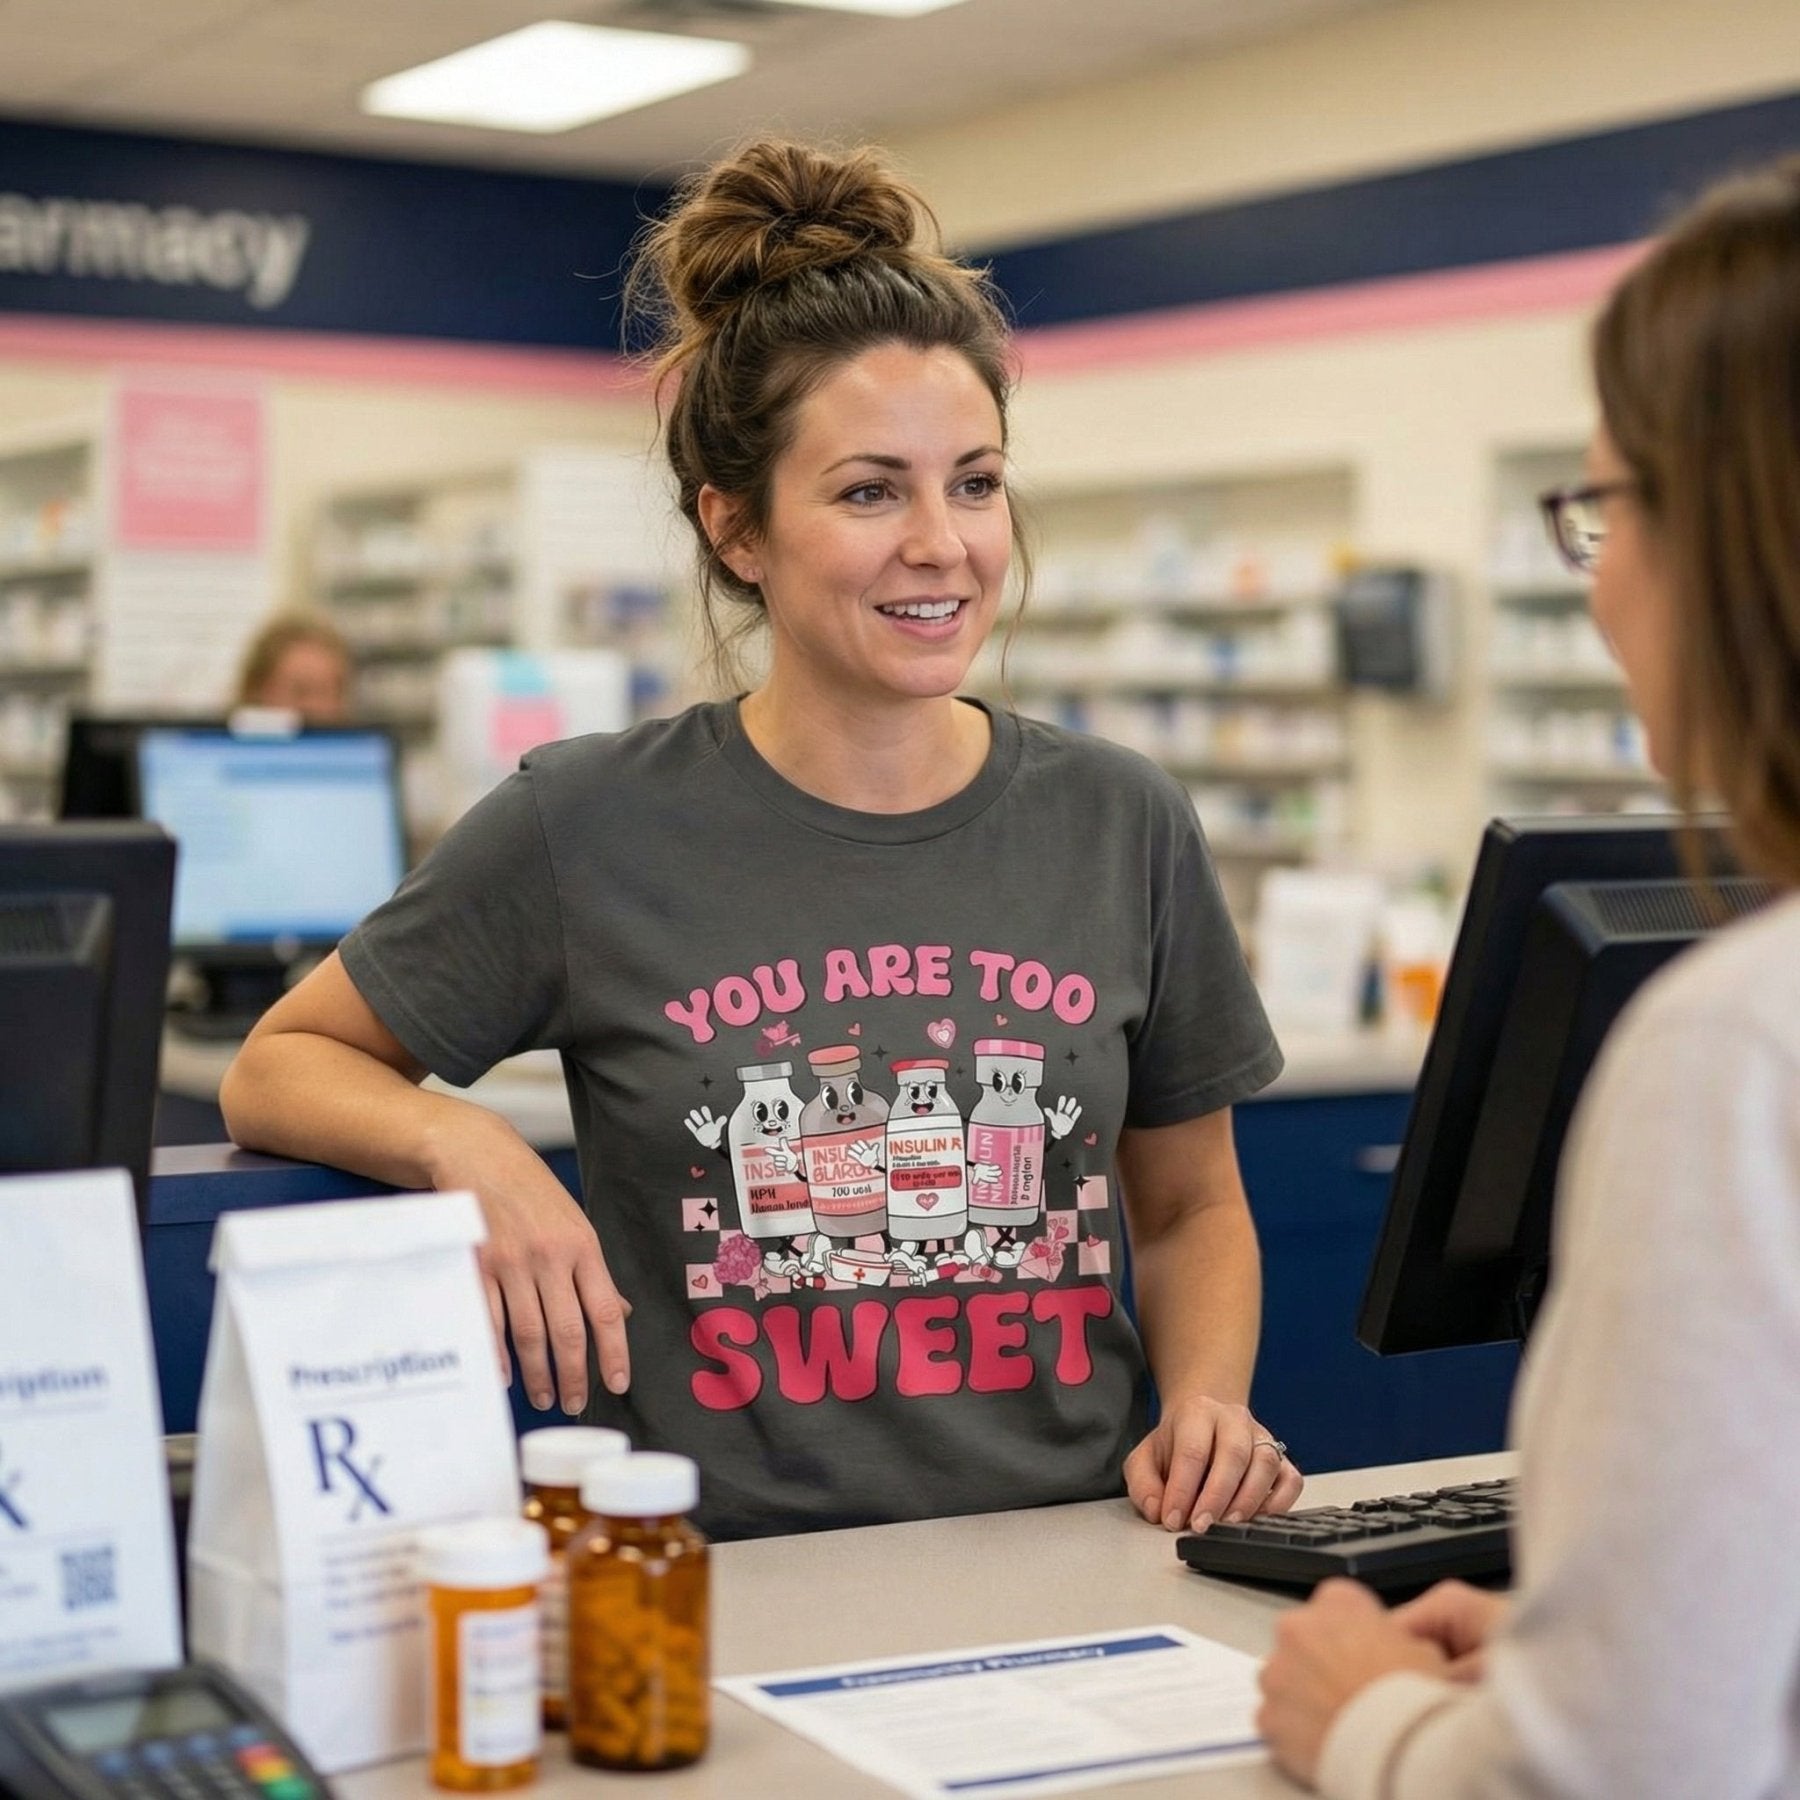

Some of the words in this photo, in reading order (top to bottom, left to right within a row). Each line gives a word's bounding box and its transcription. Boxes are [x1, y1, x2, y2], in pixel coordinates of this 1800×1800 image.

[664, 958, 806, 1043] YOU
[823, 943, 954, 1003] ARE
[969, 949, 1097, 1026] TOO
[889, 1137, 948, 1156] INSULIN
[289, 1350, 460, 1389] Prescription
[691, 1284, 1113, 1411] SWEET
[307, 1415, 391, 1523] Rx
